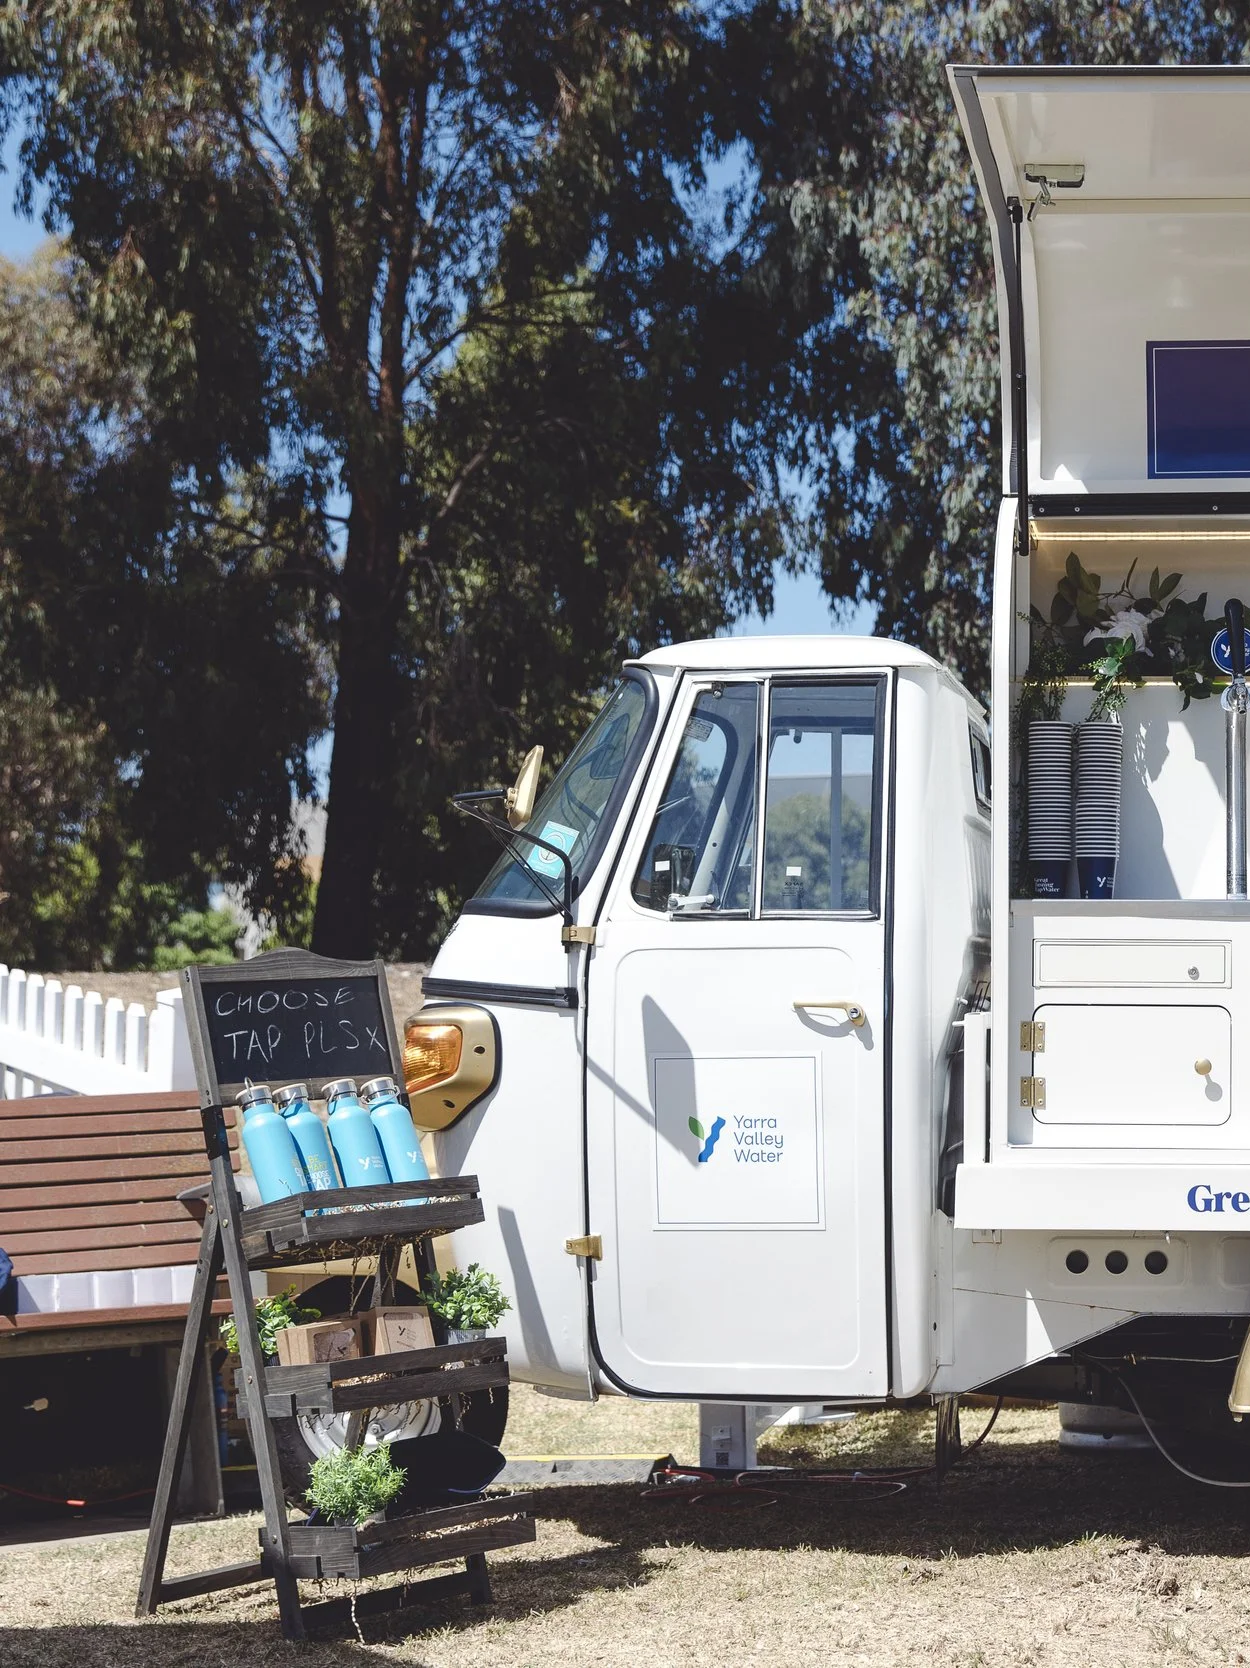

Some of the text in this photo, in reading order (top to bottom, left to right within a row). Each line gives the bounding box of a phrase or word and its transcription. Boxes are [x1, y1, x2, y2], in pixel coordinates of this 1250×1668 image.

[216, 986, 356, 1016] CHOOSE
[224, 1024, 282, 1063] TAP
[733, 1115, 777, 1129] Yarra
[733, 1131, 784, 1149] Valley
[733, 1149, 783, 1163] Water
